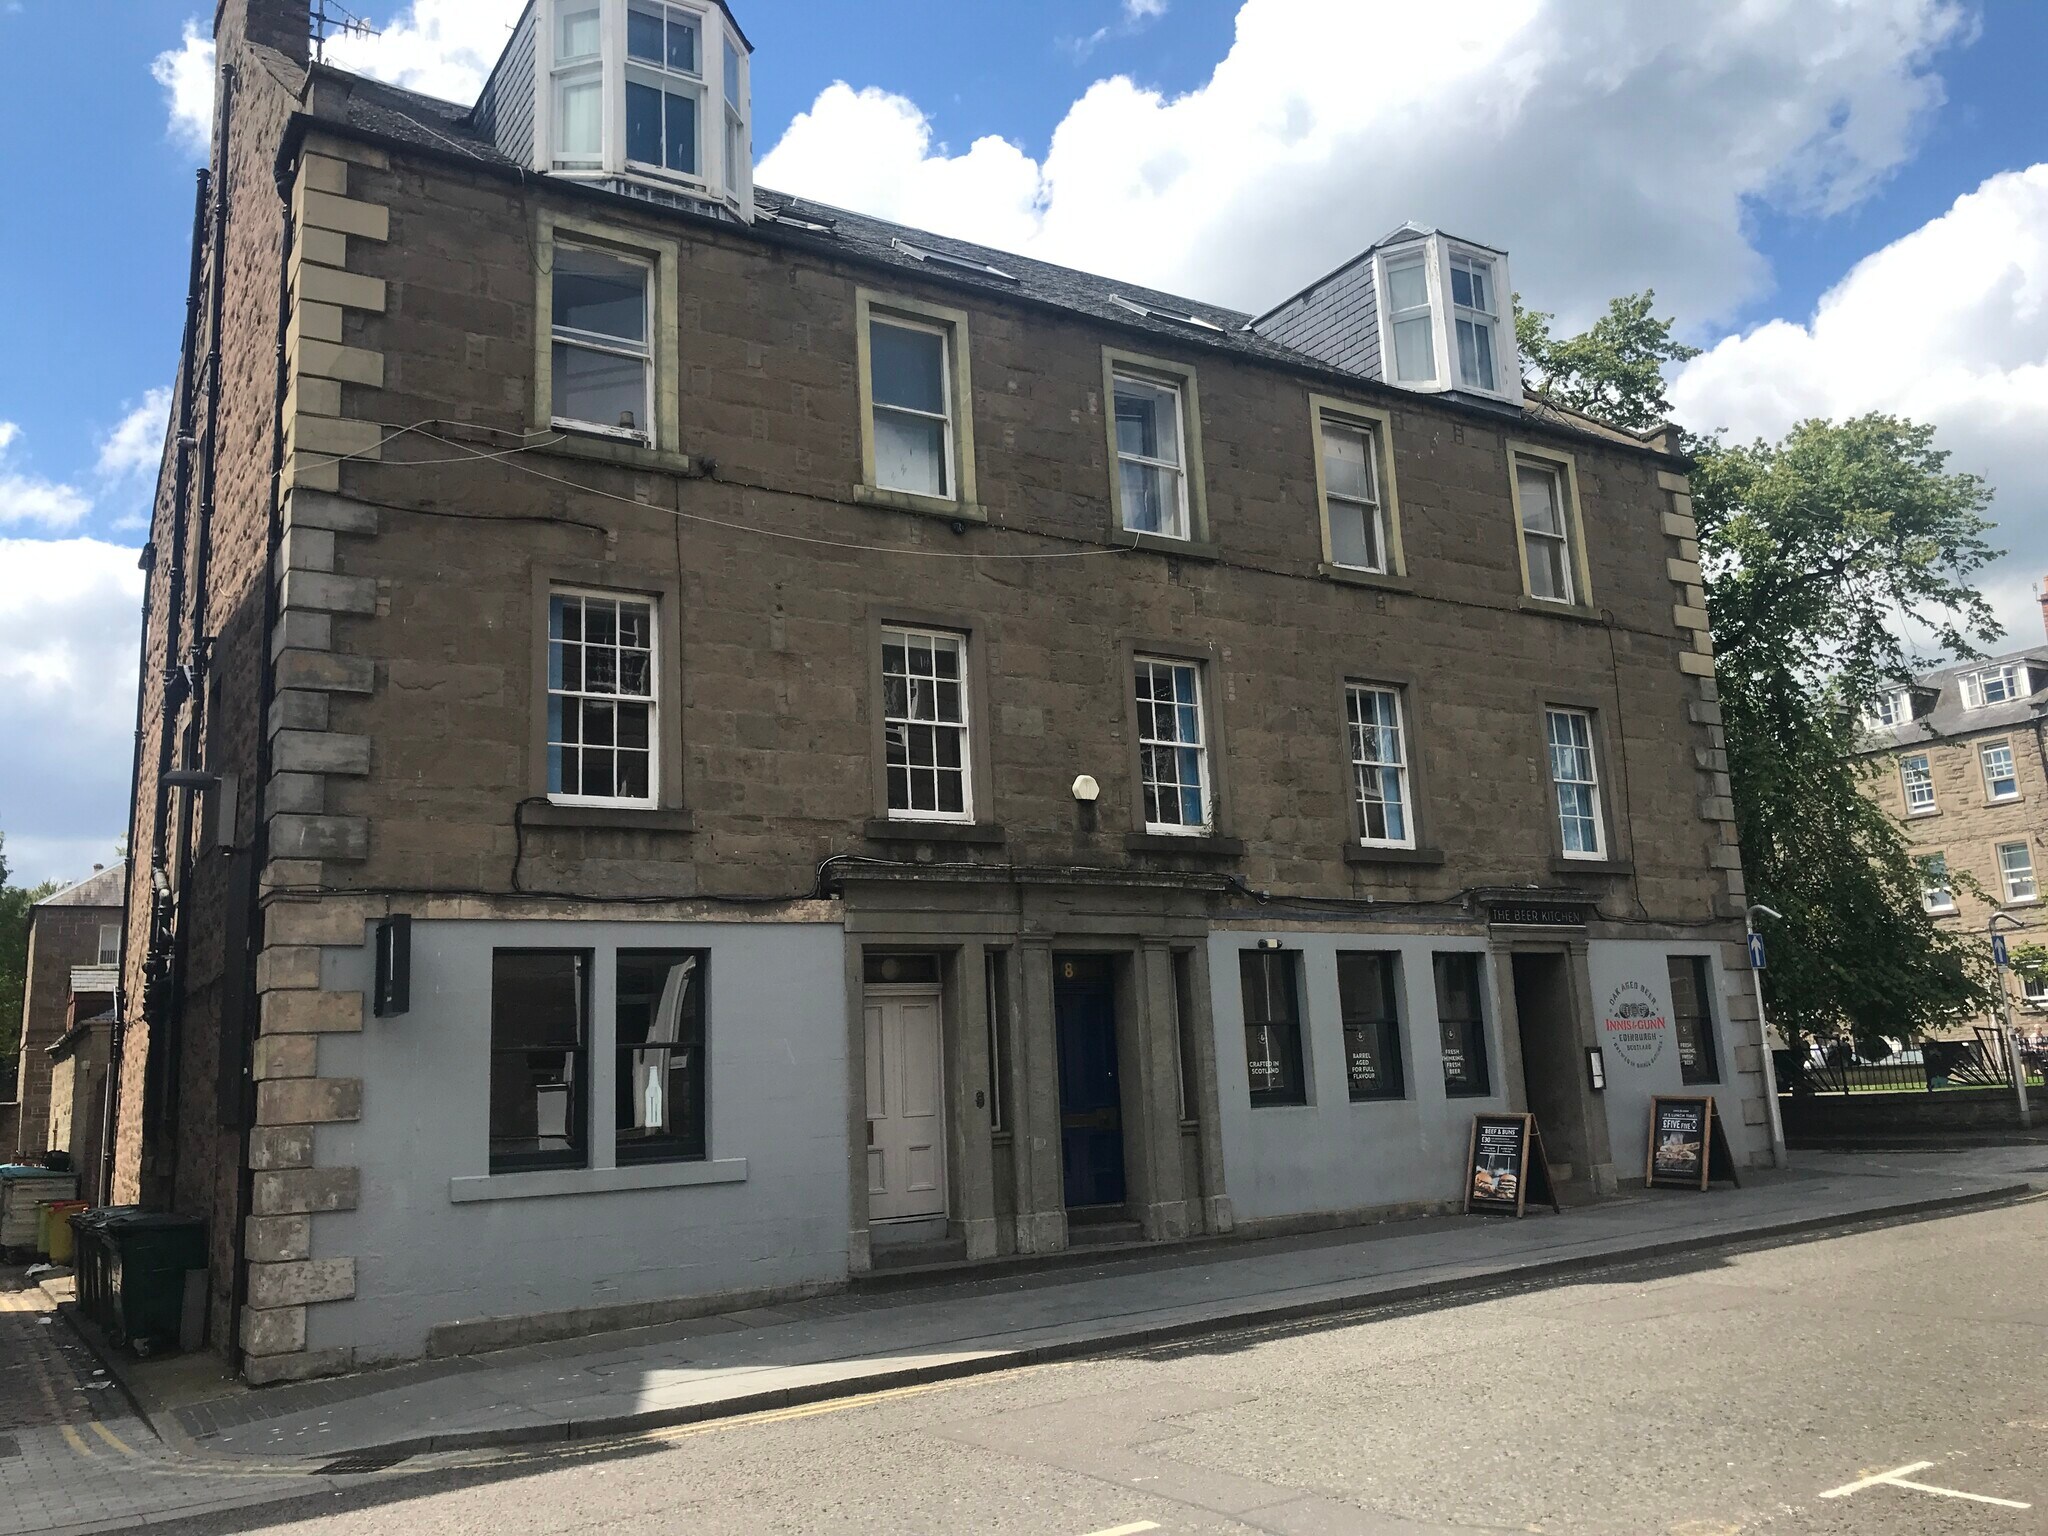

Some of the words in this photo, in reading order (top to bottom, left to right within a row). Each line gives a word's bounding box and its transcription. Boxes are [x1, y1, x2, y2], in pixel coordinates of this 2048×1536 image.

[1493, 909, 1511, 921] THE
[1514, 909, 1539, 921] BEER
[1541, 911, 1580, 923] KITCHEN
[1065, 962, 1074, 978] 8
[1609, 987, 1621, 1006] OAK
[1621, 981, 1639, 992] AGED
[1619, 1032, 1657, 1042] EDINBURGH
[1249, 1060, 1273, 1068] CRAFTED
[1251, 1067, 1280, 1075] SCOTLAND
[1663, 1119, 1681, 1129] £FIVE
[1680, 1122, 1691, 1130] FIVE
